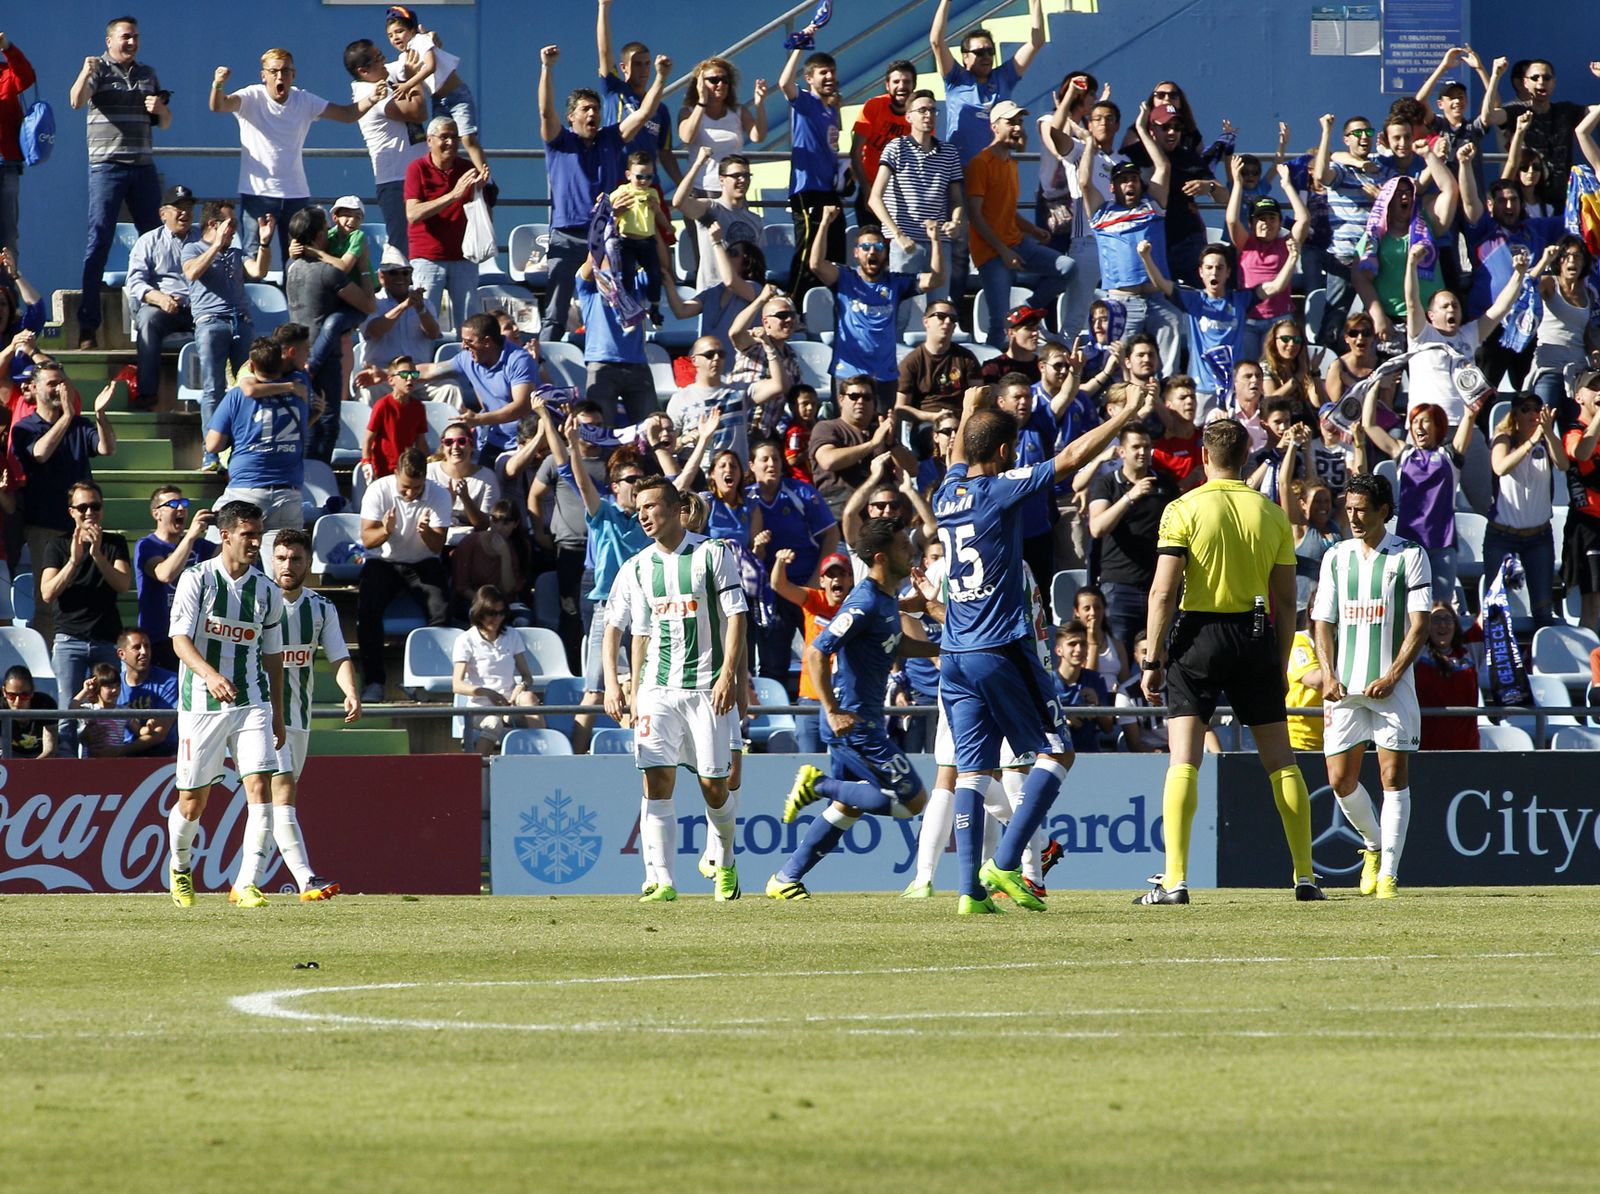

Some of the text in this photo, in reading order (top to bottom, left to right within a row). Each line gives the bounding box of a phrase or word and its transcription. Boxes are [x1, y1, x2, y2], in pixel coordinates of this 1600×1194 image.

[254, 405, 300, 442] 12
[650, 599, 698, 617] ango
[1344, 603, 1385, 621] tango
[204, 618, 255, 643] tango
[637, 715, 652, 737] 3
[881, 753, 911, 784] 20
[956, 813, 970, 830] GTF
[1446, 789, 1600, 873] City
